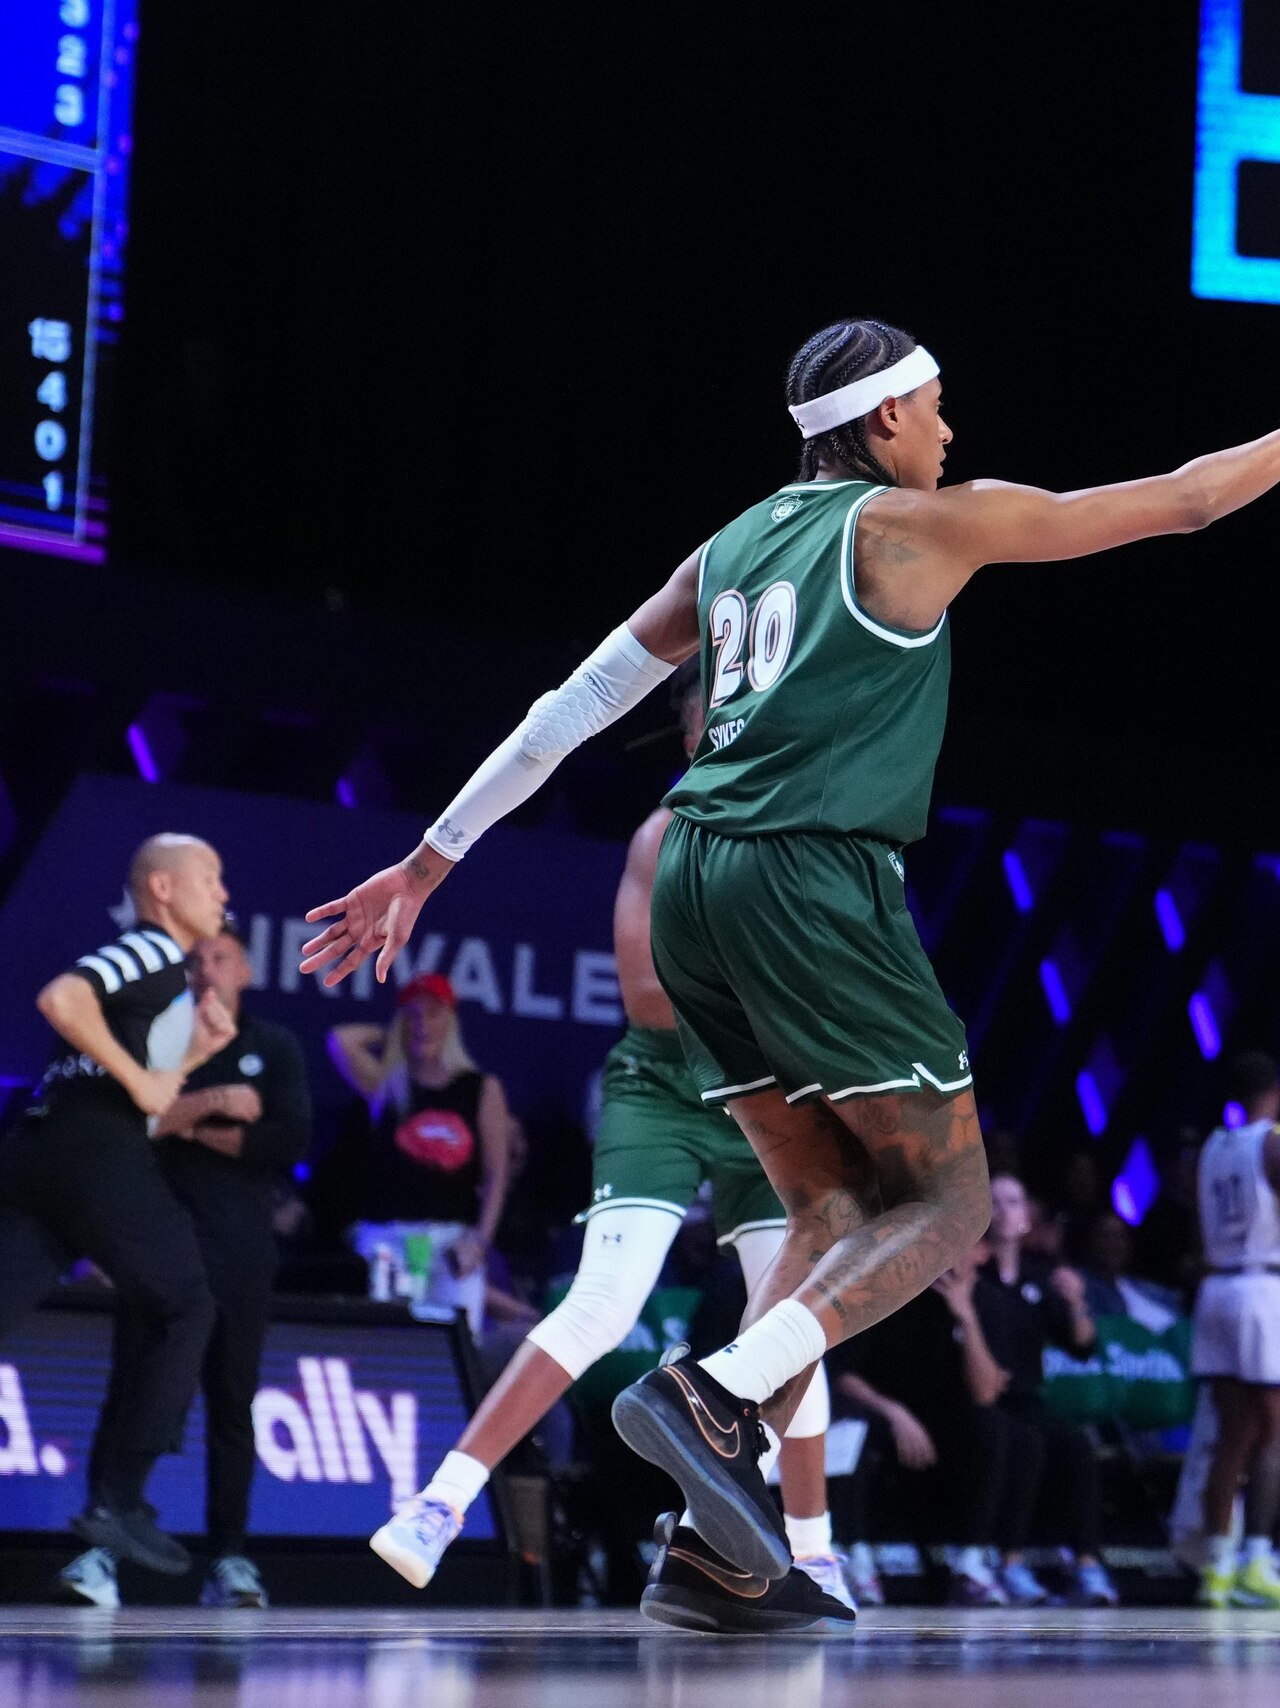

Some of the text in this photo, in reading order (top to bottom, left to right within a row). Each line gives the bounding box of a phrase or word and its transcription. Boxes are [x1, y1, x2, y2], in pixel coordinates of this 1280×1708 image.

[37, 370, 68, 413] 4
[34, 419, 68, 463] 0
[42, 470, 64, 512] 1
[709, 580, 797, 709] 20
[250, 1355, 419, 1515] ally
